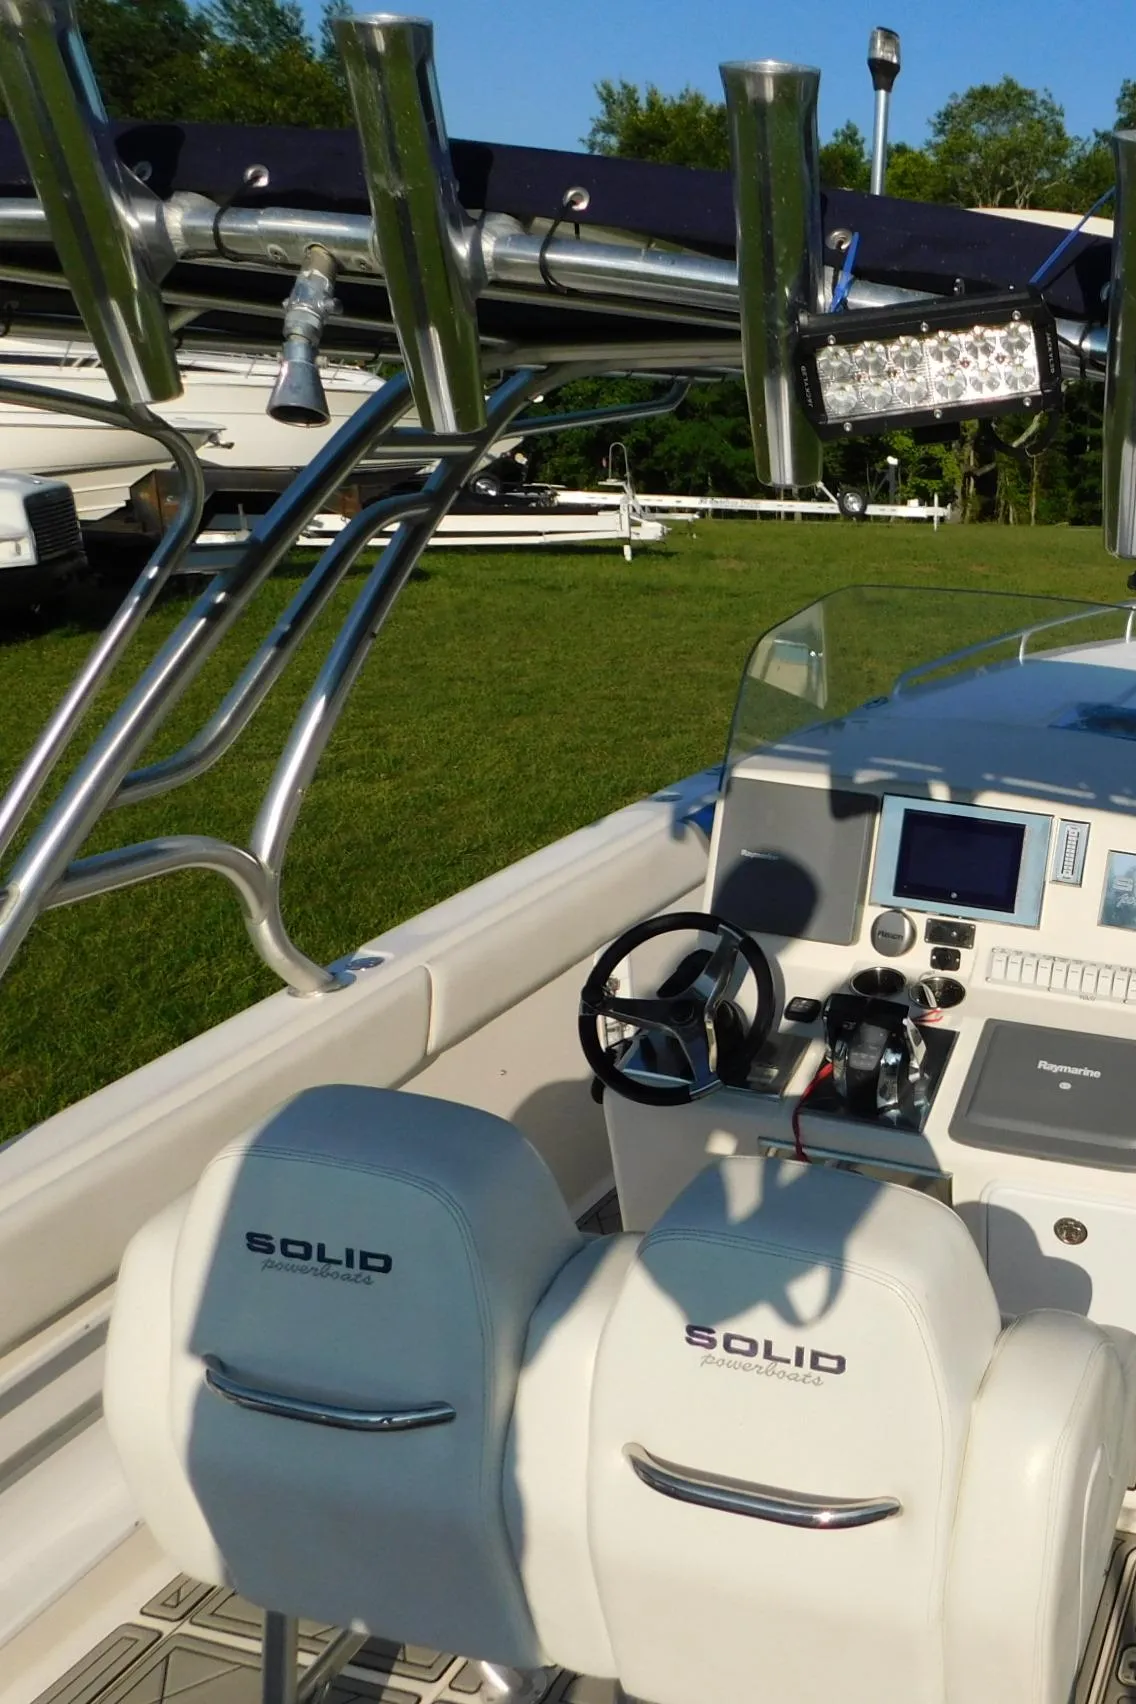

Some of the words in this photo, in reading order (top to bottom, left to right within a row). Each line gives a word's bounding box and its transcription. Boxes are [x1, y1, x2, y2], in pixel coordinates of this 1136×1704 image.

[1037, 1060, 1102, 1079] Raymarine
[245, 1231, 393, 1274] SOLID
[261, 1256, 374, 1286] powerboats
[685, 1323, 847, 1375] SOLID
[700, 1352, 824, 1387] powerboats
